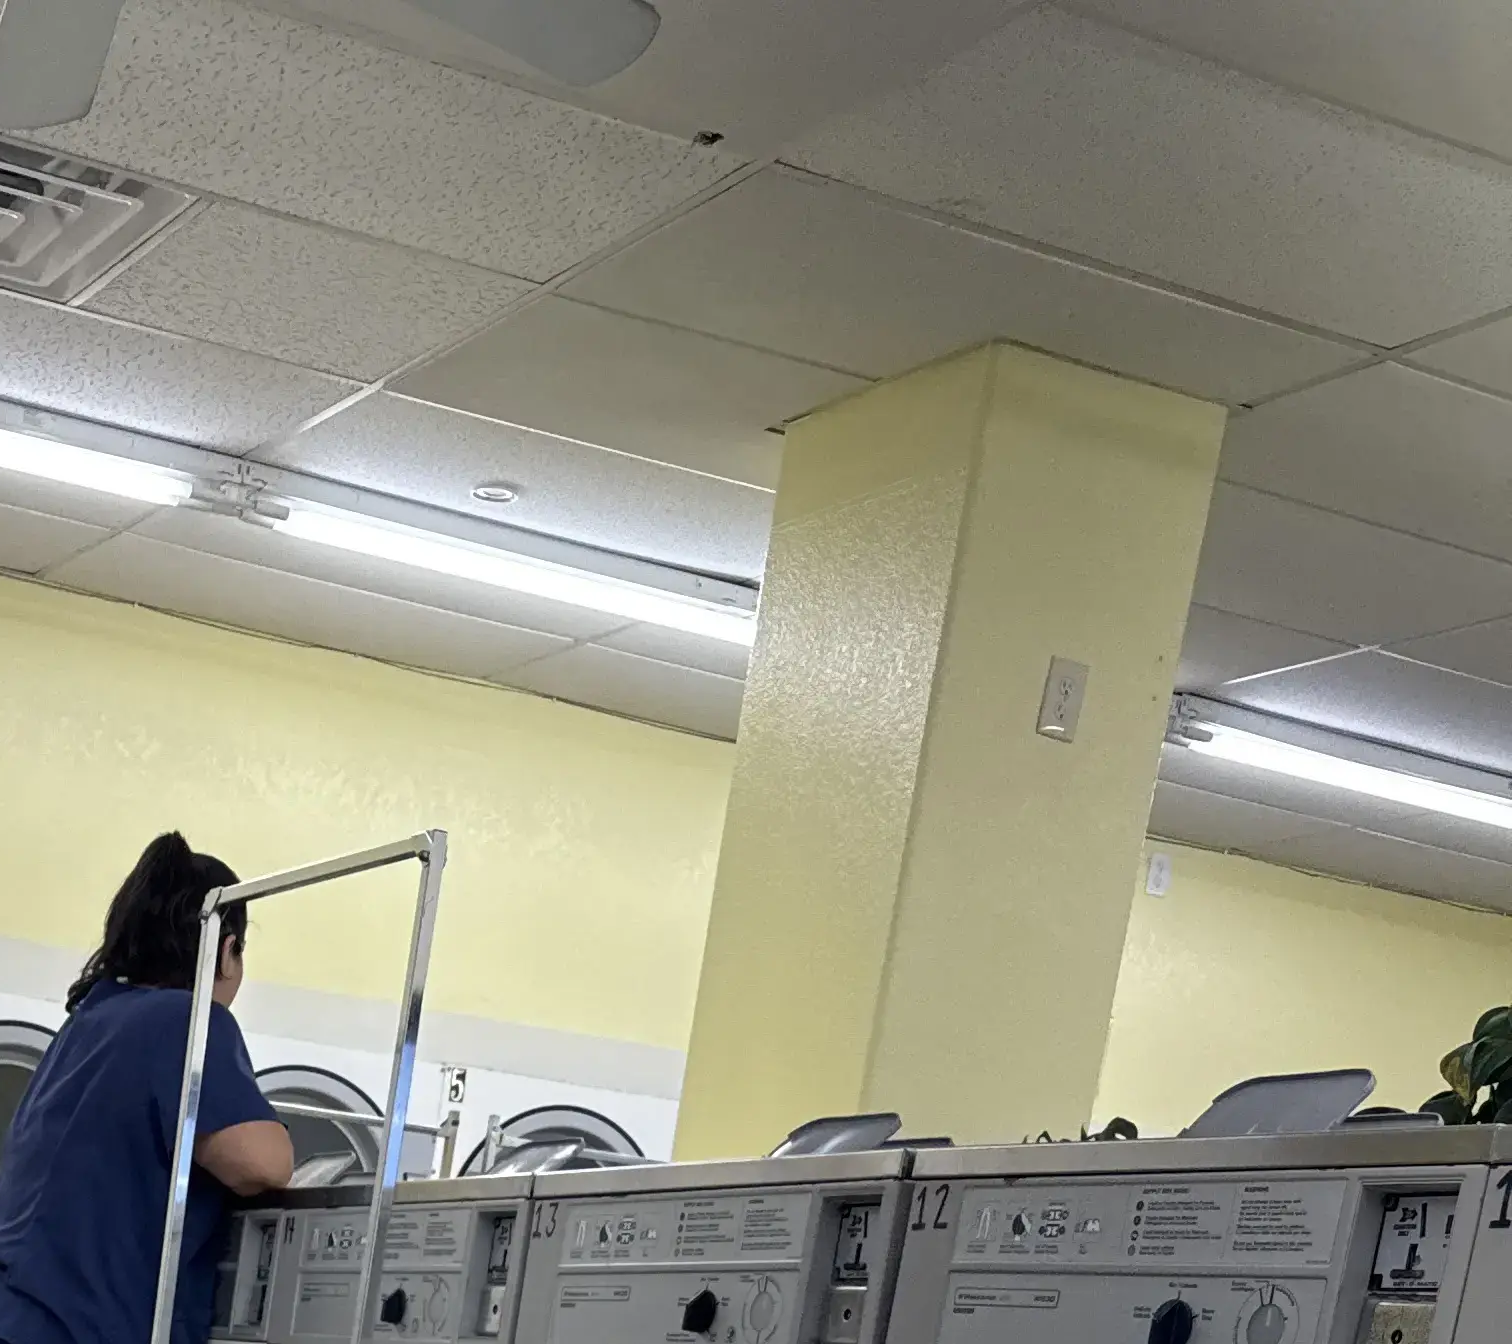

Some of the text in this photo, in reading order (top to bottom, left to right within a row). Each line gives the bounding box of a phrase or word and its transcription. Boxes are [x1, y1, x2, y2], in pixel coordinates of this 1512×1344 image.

[450, 1064, 466, 1103] 5
[532, 1202, 559, 1240] 13
[910, 1183, 950, 1231] 12
